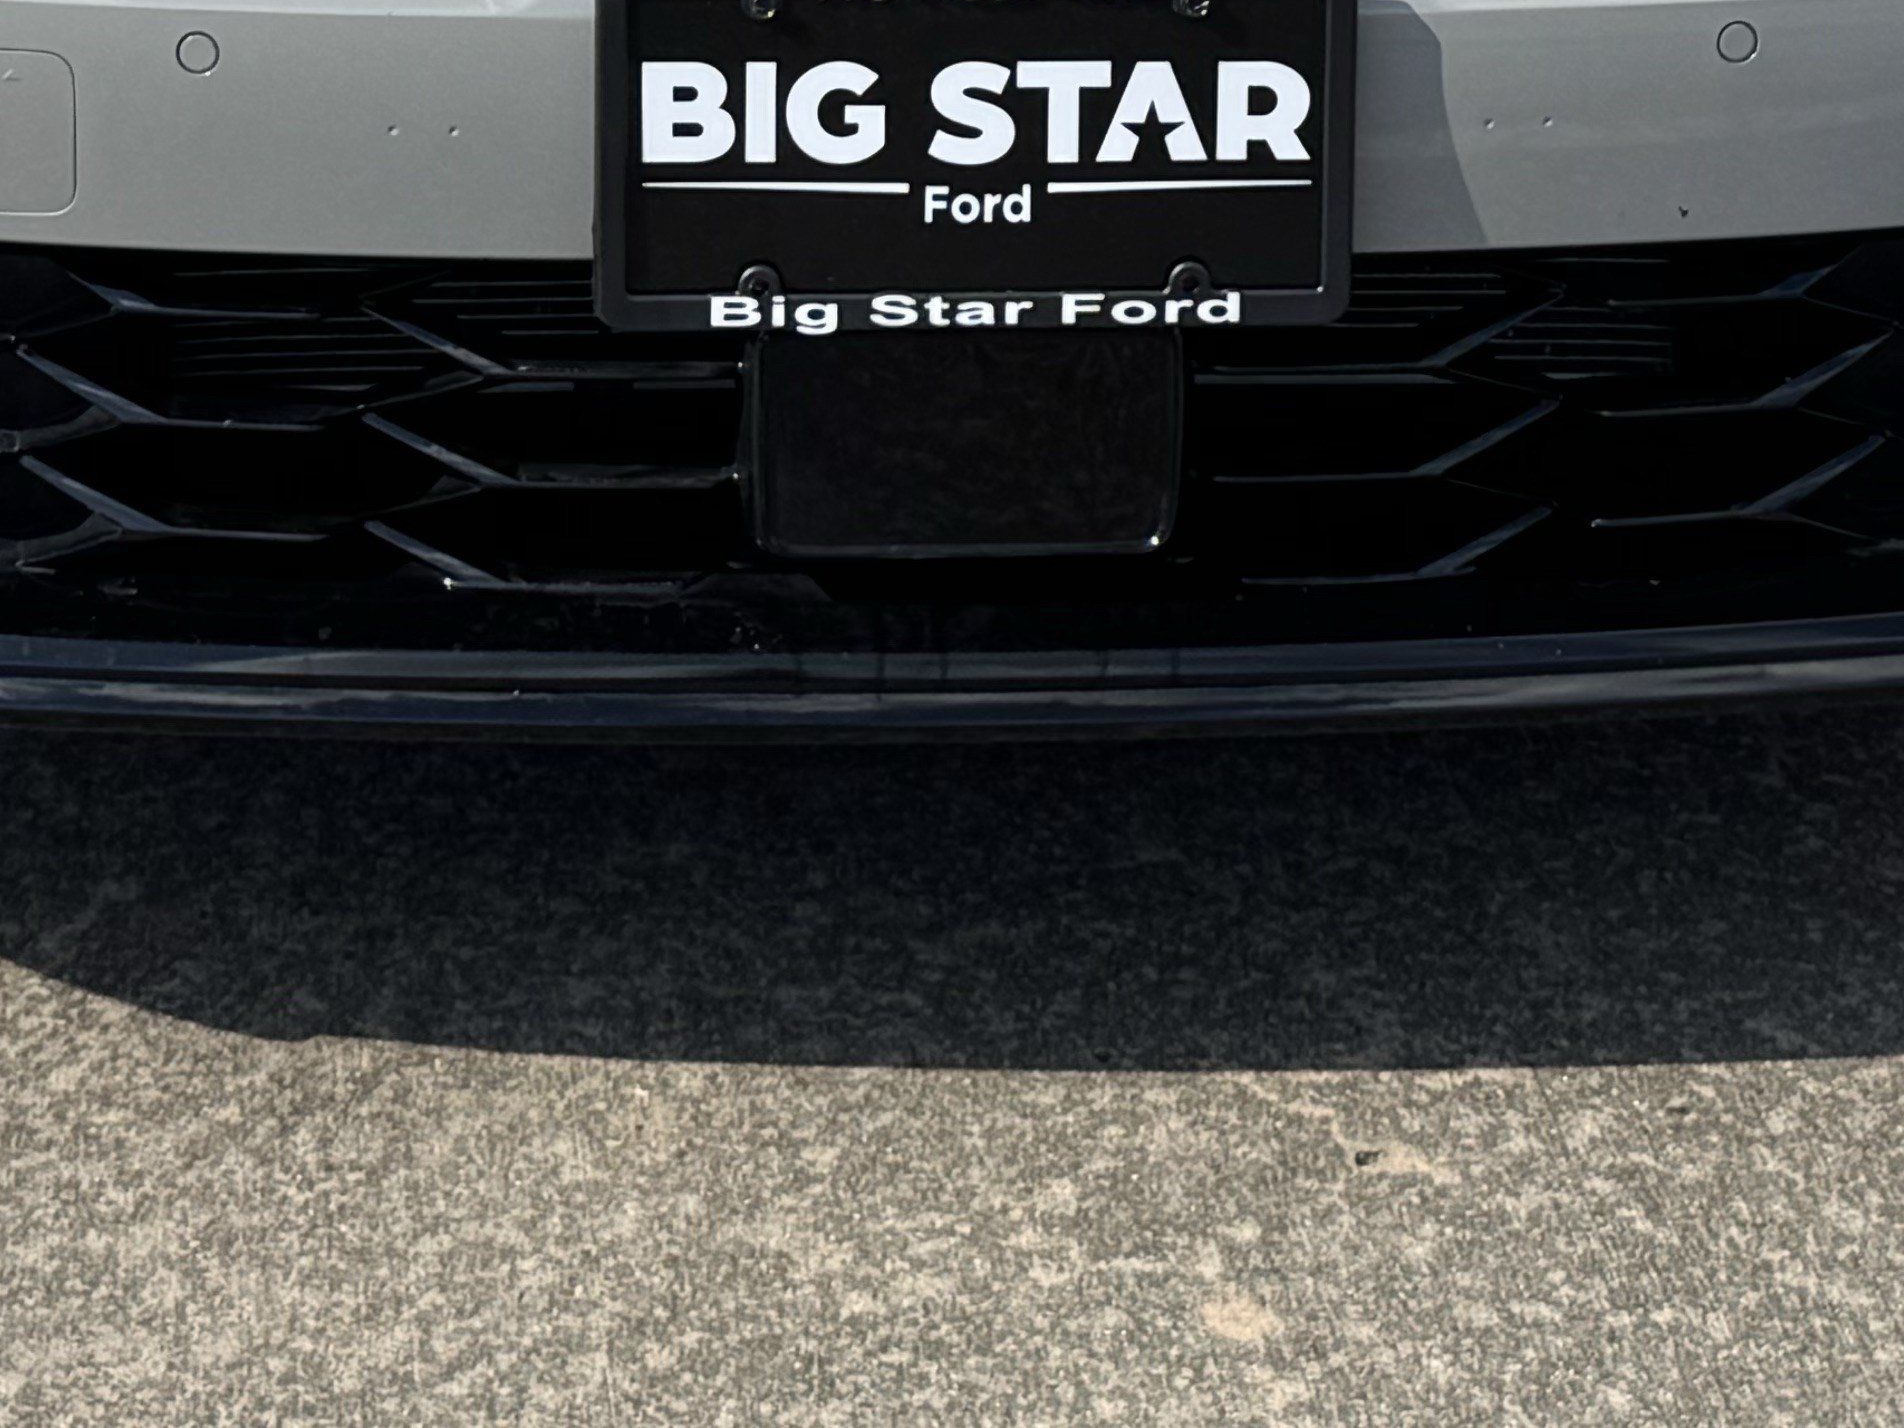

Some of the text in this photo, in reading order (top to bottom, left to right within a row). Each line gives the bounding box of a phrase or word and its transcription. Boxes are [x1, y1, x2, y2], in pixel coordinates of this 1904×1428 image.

[641, 60, 1312, 166] BIG STAR
[924, 183, 1032, 225] Ford
[709, 289, 1242, 337] Big Star Ford
